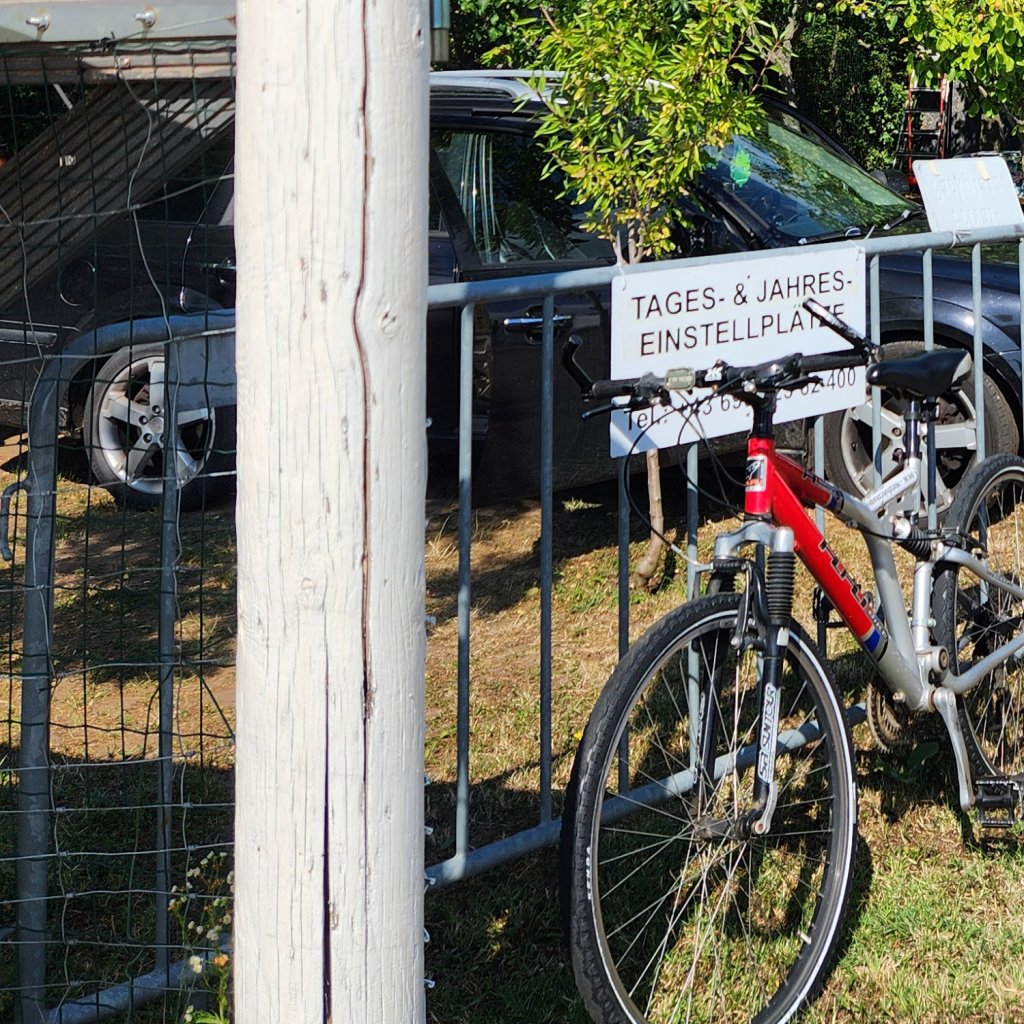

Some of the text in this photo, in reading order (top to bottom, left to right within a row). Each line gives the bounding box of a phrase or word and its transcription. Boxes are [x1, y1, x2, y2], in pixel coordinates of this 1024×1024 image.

[632, 270, 853, 320] TAGES- & JAHRES-
[640, 303, 845, 357] EINSTELLPLÄE
